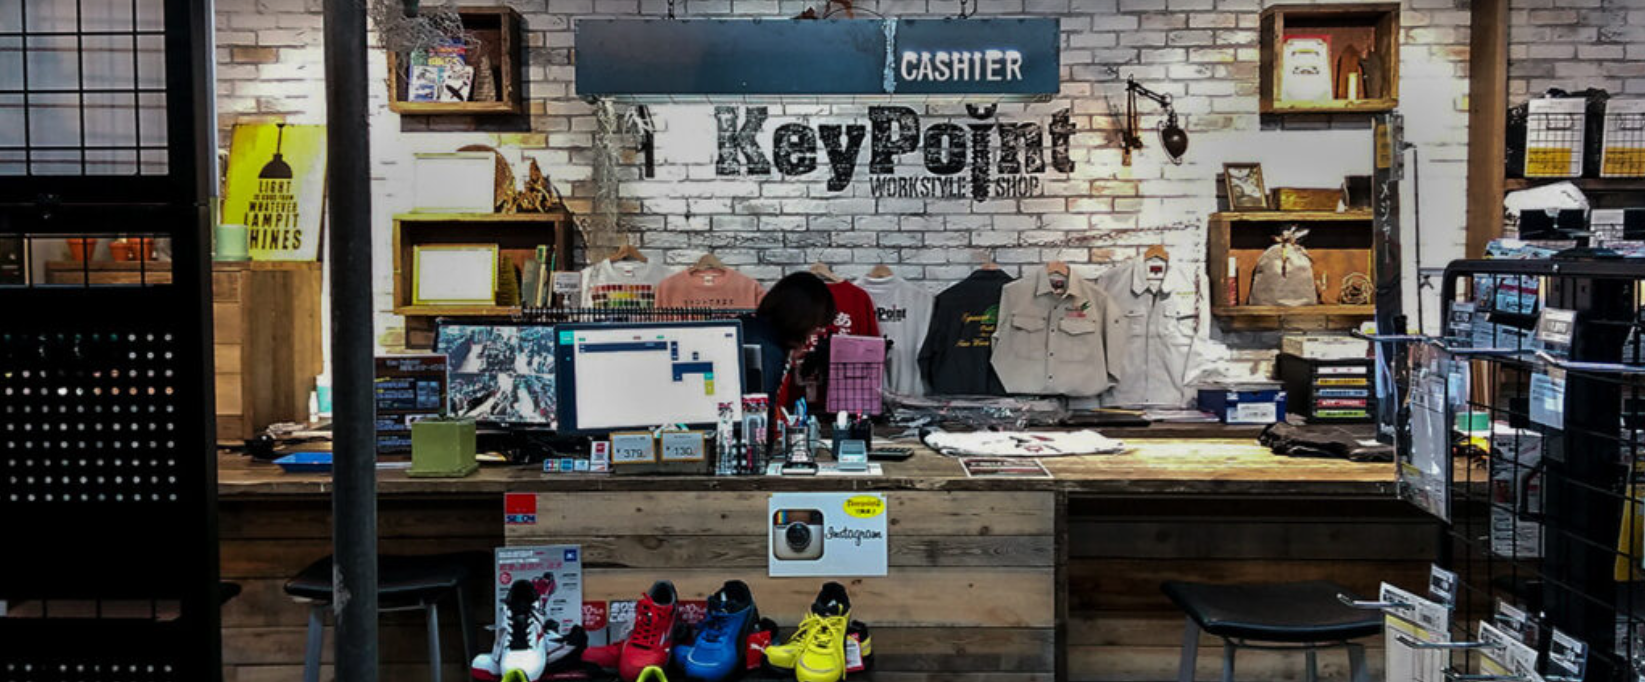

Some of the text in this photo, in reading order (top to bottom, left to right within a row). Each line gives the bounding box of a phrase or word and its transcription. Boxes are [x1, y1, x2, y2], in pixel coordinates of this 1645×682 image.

[901, 50, 1023, 81] CASHIER
[714, 103, 1076, 202] KeyPoint
[258, 181, 292, 193] LIGHT
[869, 176, 1040, 198] WORKSTYLE SHOP
[249, 201, 297, 212] WHATEVER
[249, 229, 302, 250] HINES
[875, 304, 907, 320] Point
[825, 526, 882, 546] Instagram
